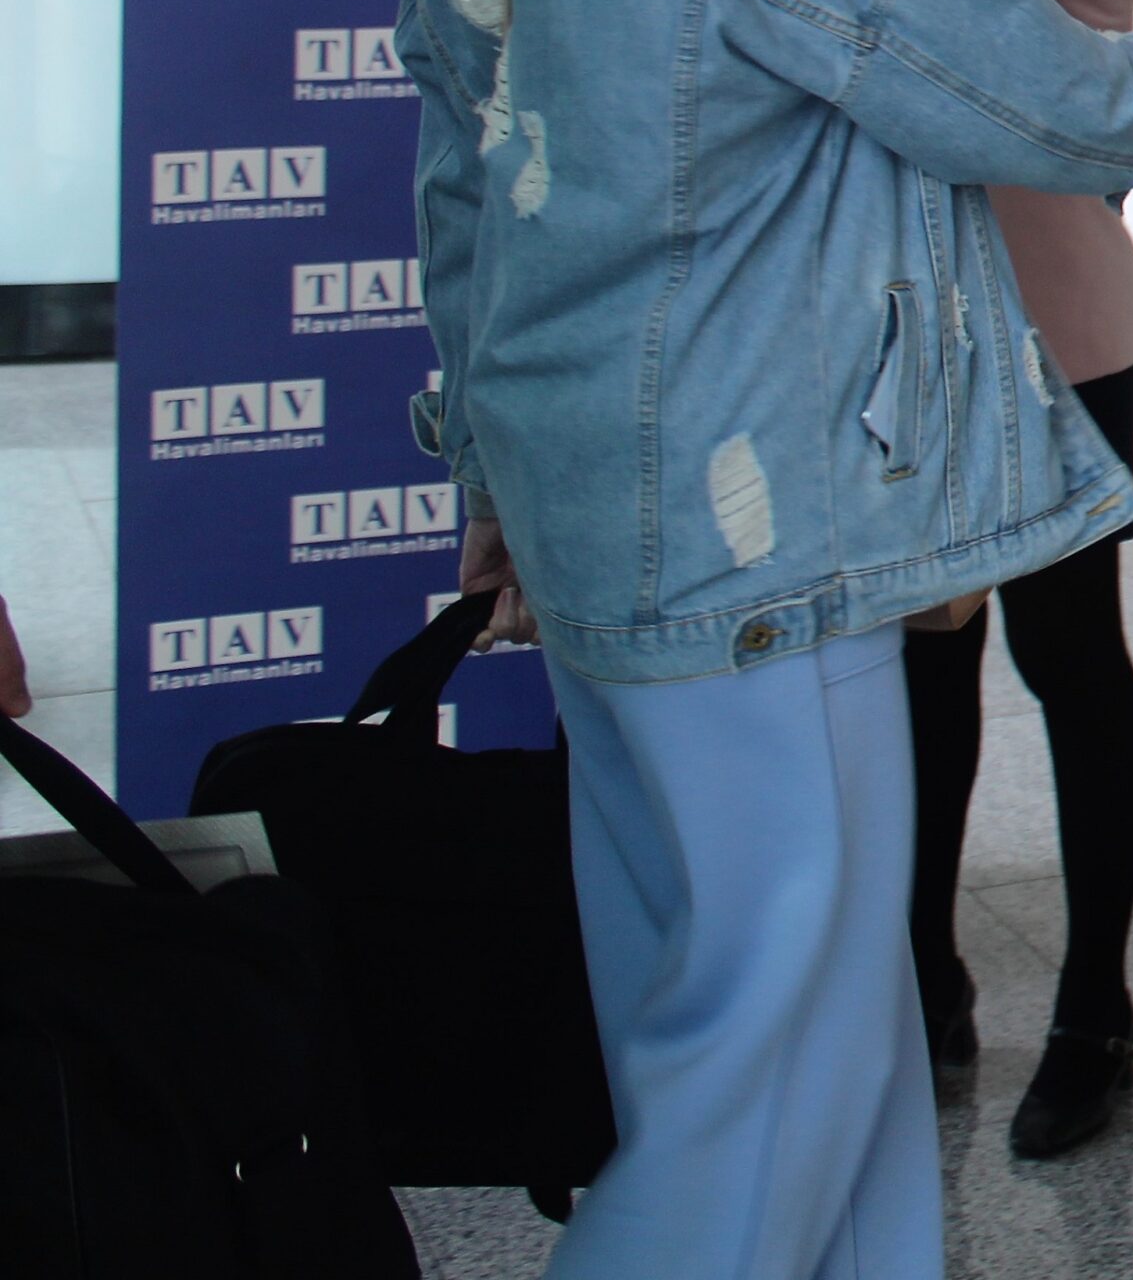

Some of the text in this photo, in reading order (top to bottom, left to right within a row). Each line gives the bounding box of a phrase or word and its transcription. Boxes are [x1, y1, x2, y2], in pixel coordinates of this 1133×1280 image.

[306, 39, 396, 73] TA
[294, 81, 420, 100] Havaliman
[163, 156, 314, 196] TAV
[152, 201, 326, 224] Havalimanları
[304, 271, 394, 307] TA
[292, 310, 428, 334] Havalimanl
[163, 389, 315, 432] TAV
[151, 432, 325, 460] Havalimanları
[304, 492, 447, 536] TAV
[290, 535, 457, 563] Havalimanları
[162, 615, 314, 664] TAV
[150, 659, 324, 691] Havalimanları
